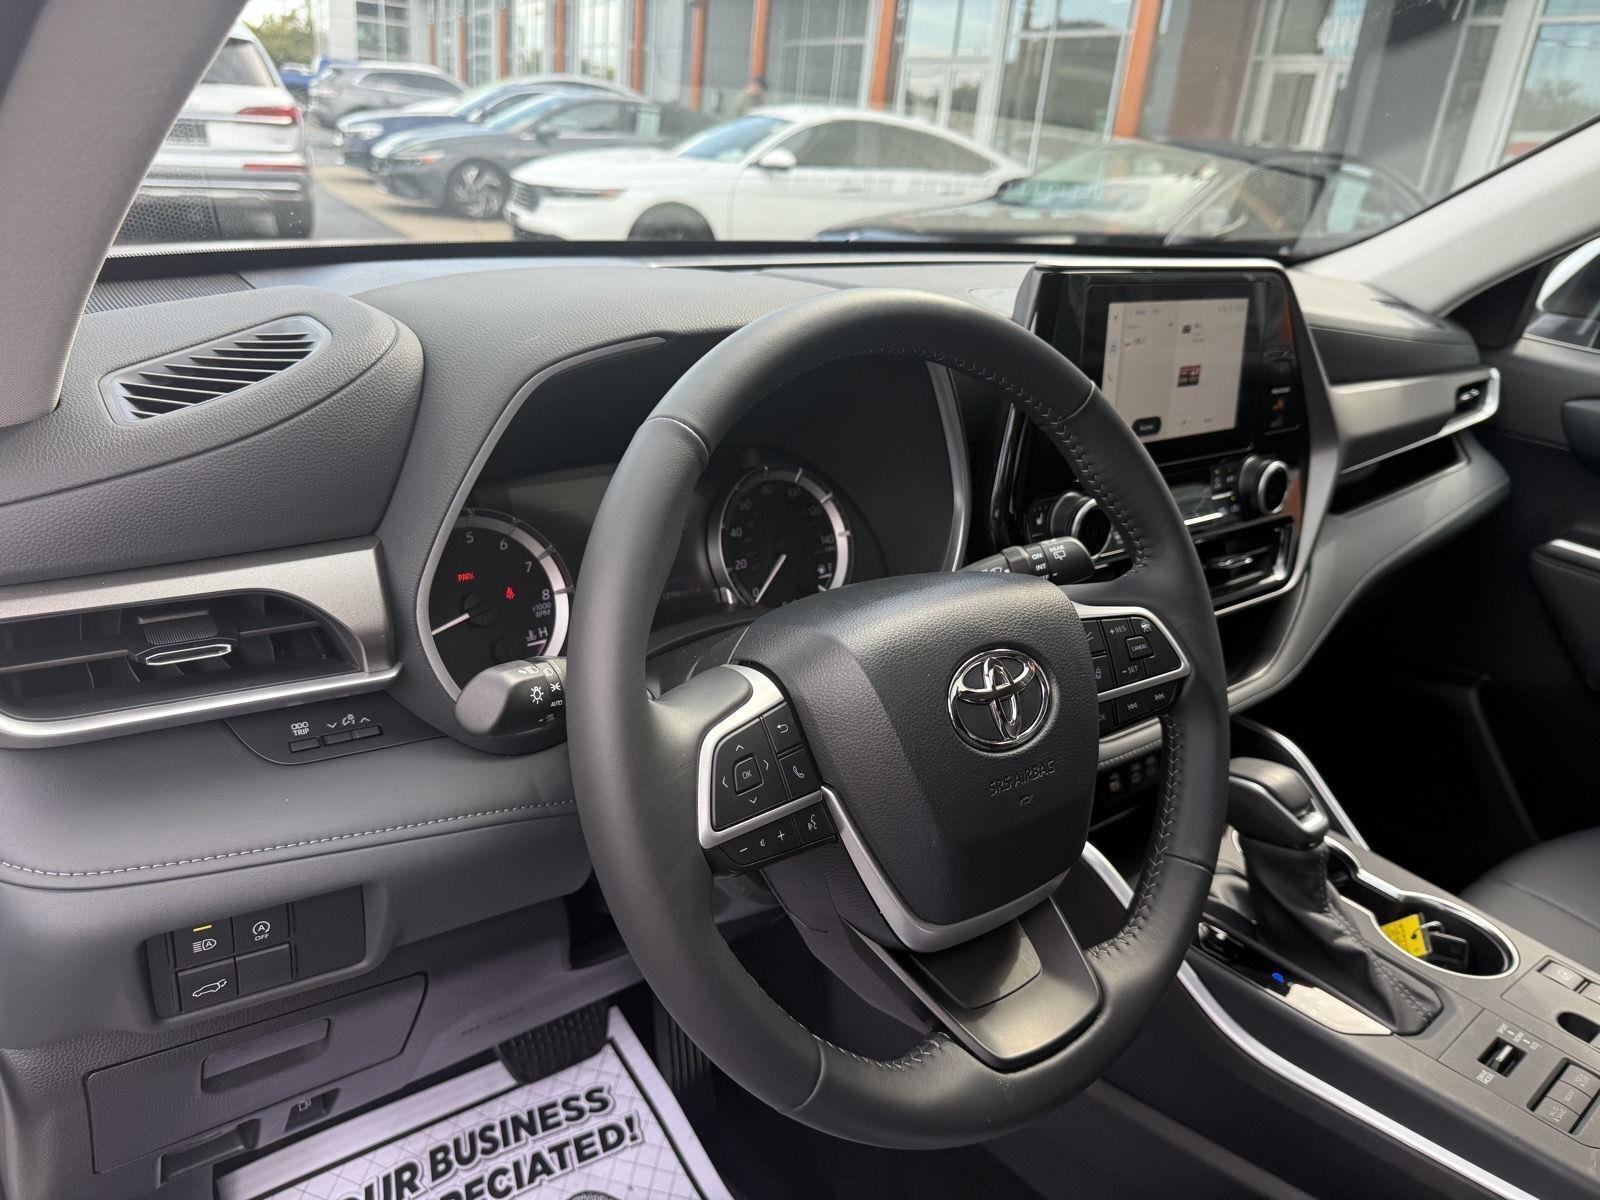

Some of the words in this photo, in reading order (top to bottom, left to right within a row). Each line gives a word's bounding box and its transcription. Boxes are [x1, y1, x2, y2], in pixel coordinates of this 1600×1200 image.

[466, 532, 474, 543] 5
[730, 527, 743, 538] 40
[500, 539, 508, 550] 6
[525, 562, 532, 573] 7
[734, 558, 748, 571] 20
[1036, 563, 1047, 571] INT
[457, 571, 475, 582] PARK
[542, 589, 550, 600] 8
[538, 627, 548, 637] H
[550, 699, 563, 708] AUTO
[290, 721, 309, 731] ODO
[292, 727, 310, 737] TRIP
[742, 770, 752, 779] OK
[254, 932, 269, 942] OFF
[429, 1085, 613, 1182] BUSINESS
